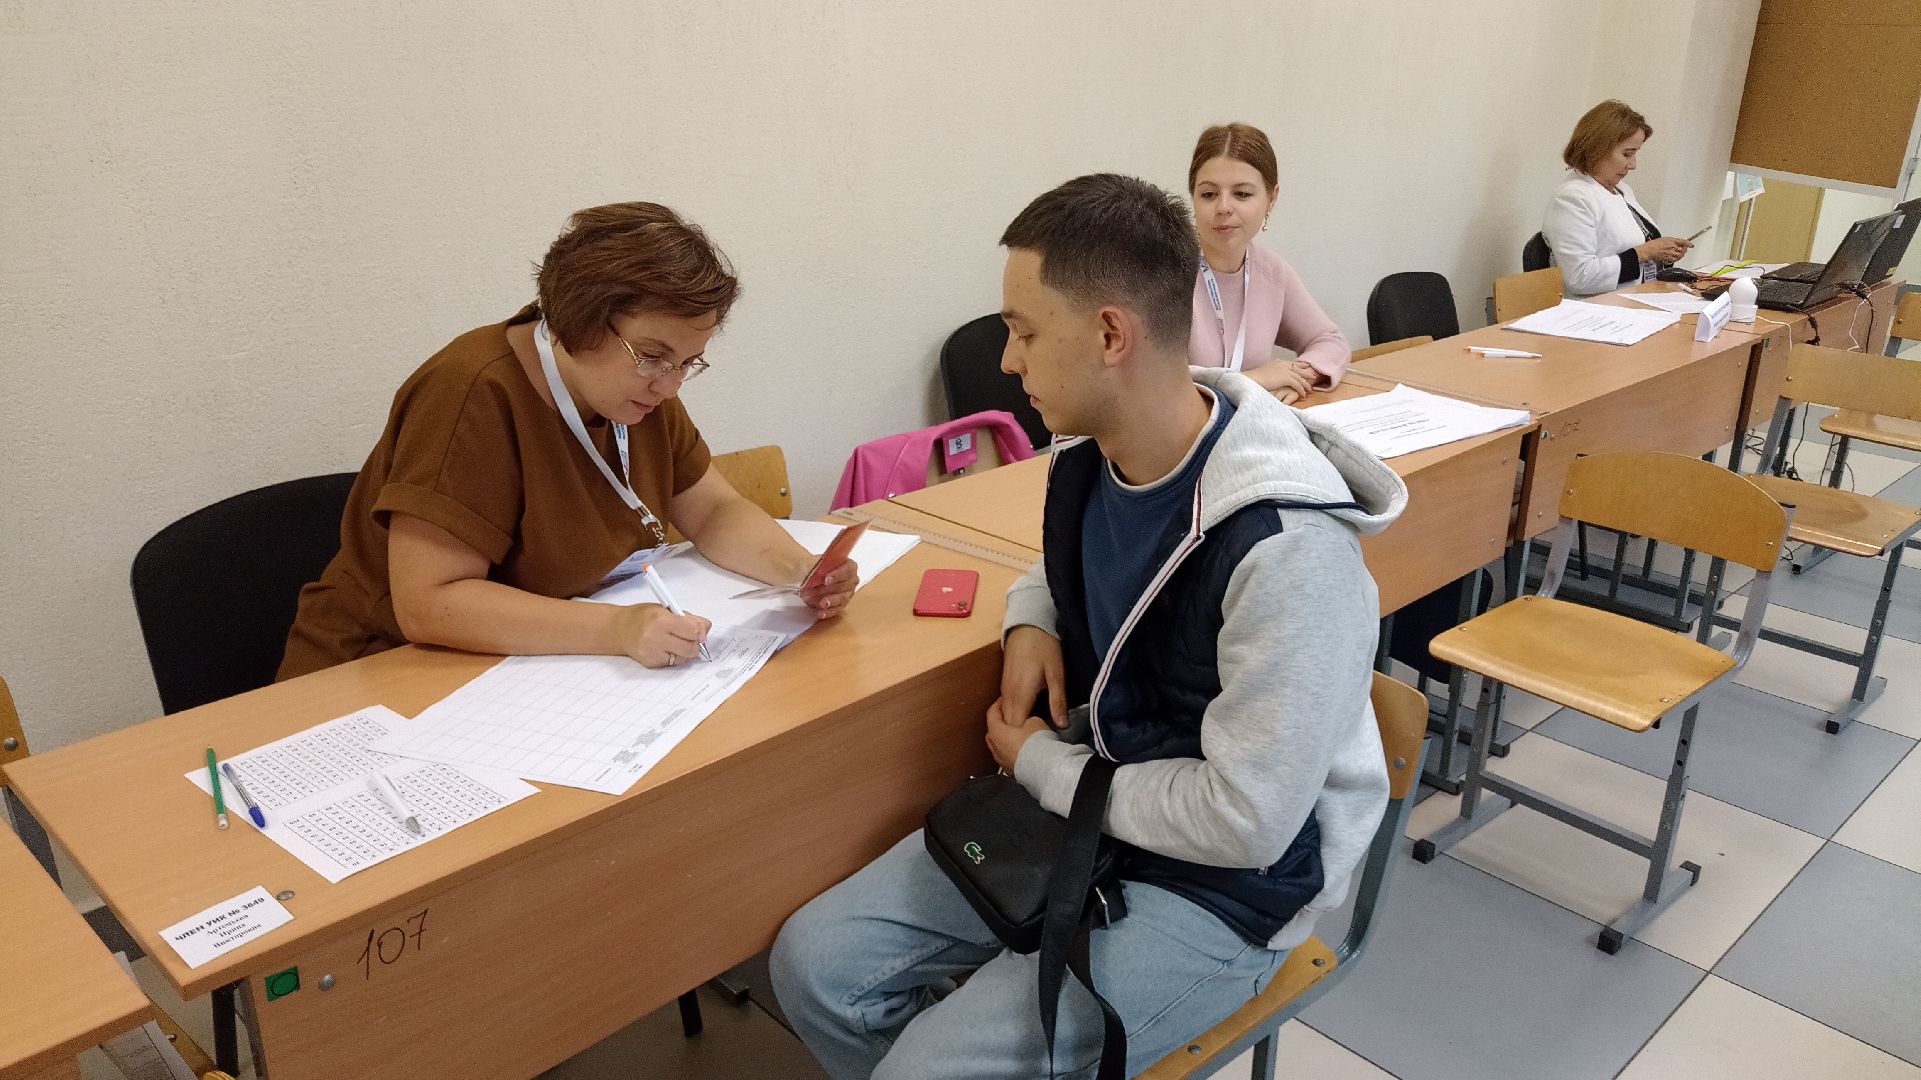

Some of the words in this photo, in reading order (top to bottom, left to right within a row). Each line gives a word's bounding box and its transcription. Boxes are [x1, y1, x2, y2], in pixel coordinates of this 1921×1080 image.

[174, 924, 205, 941] ЧЛЕН
[206, 914, 227, 927] УИК
[357, 908, 429, 980] 107
